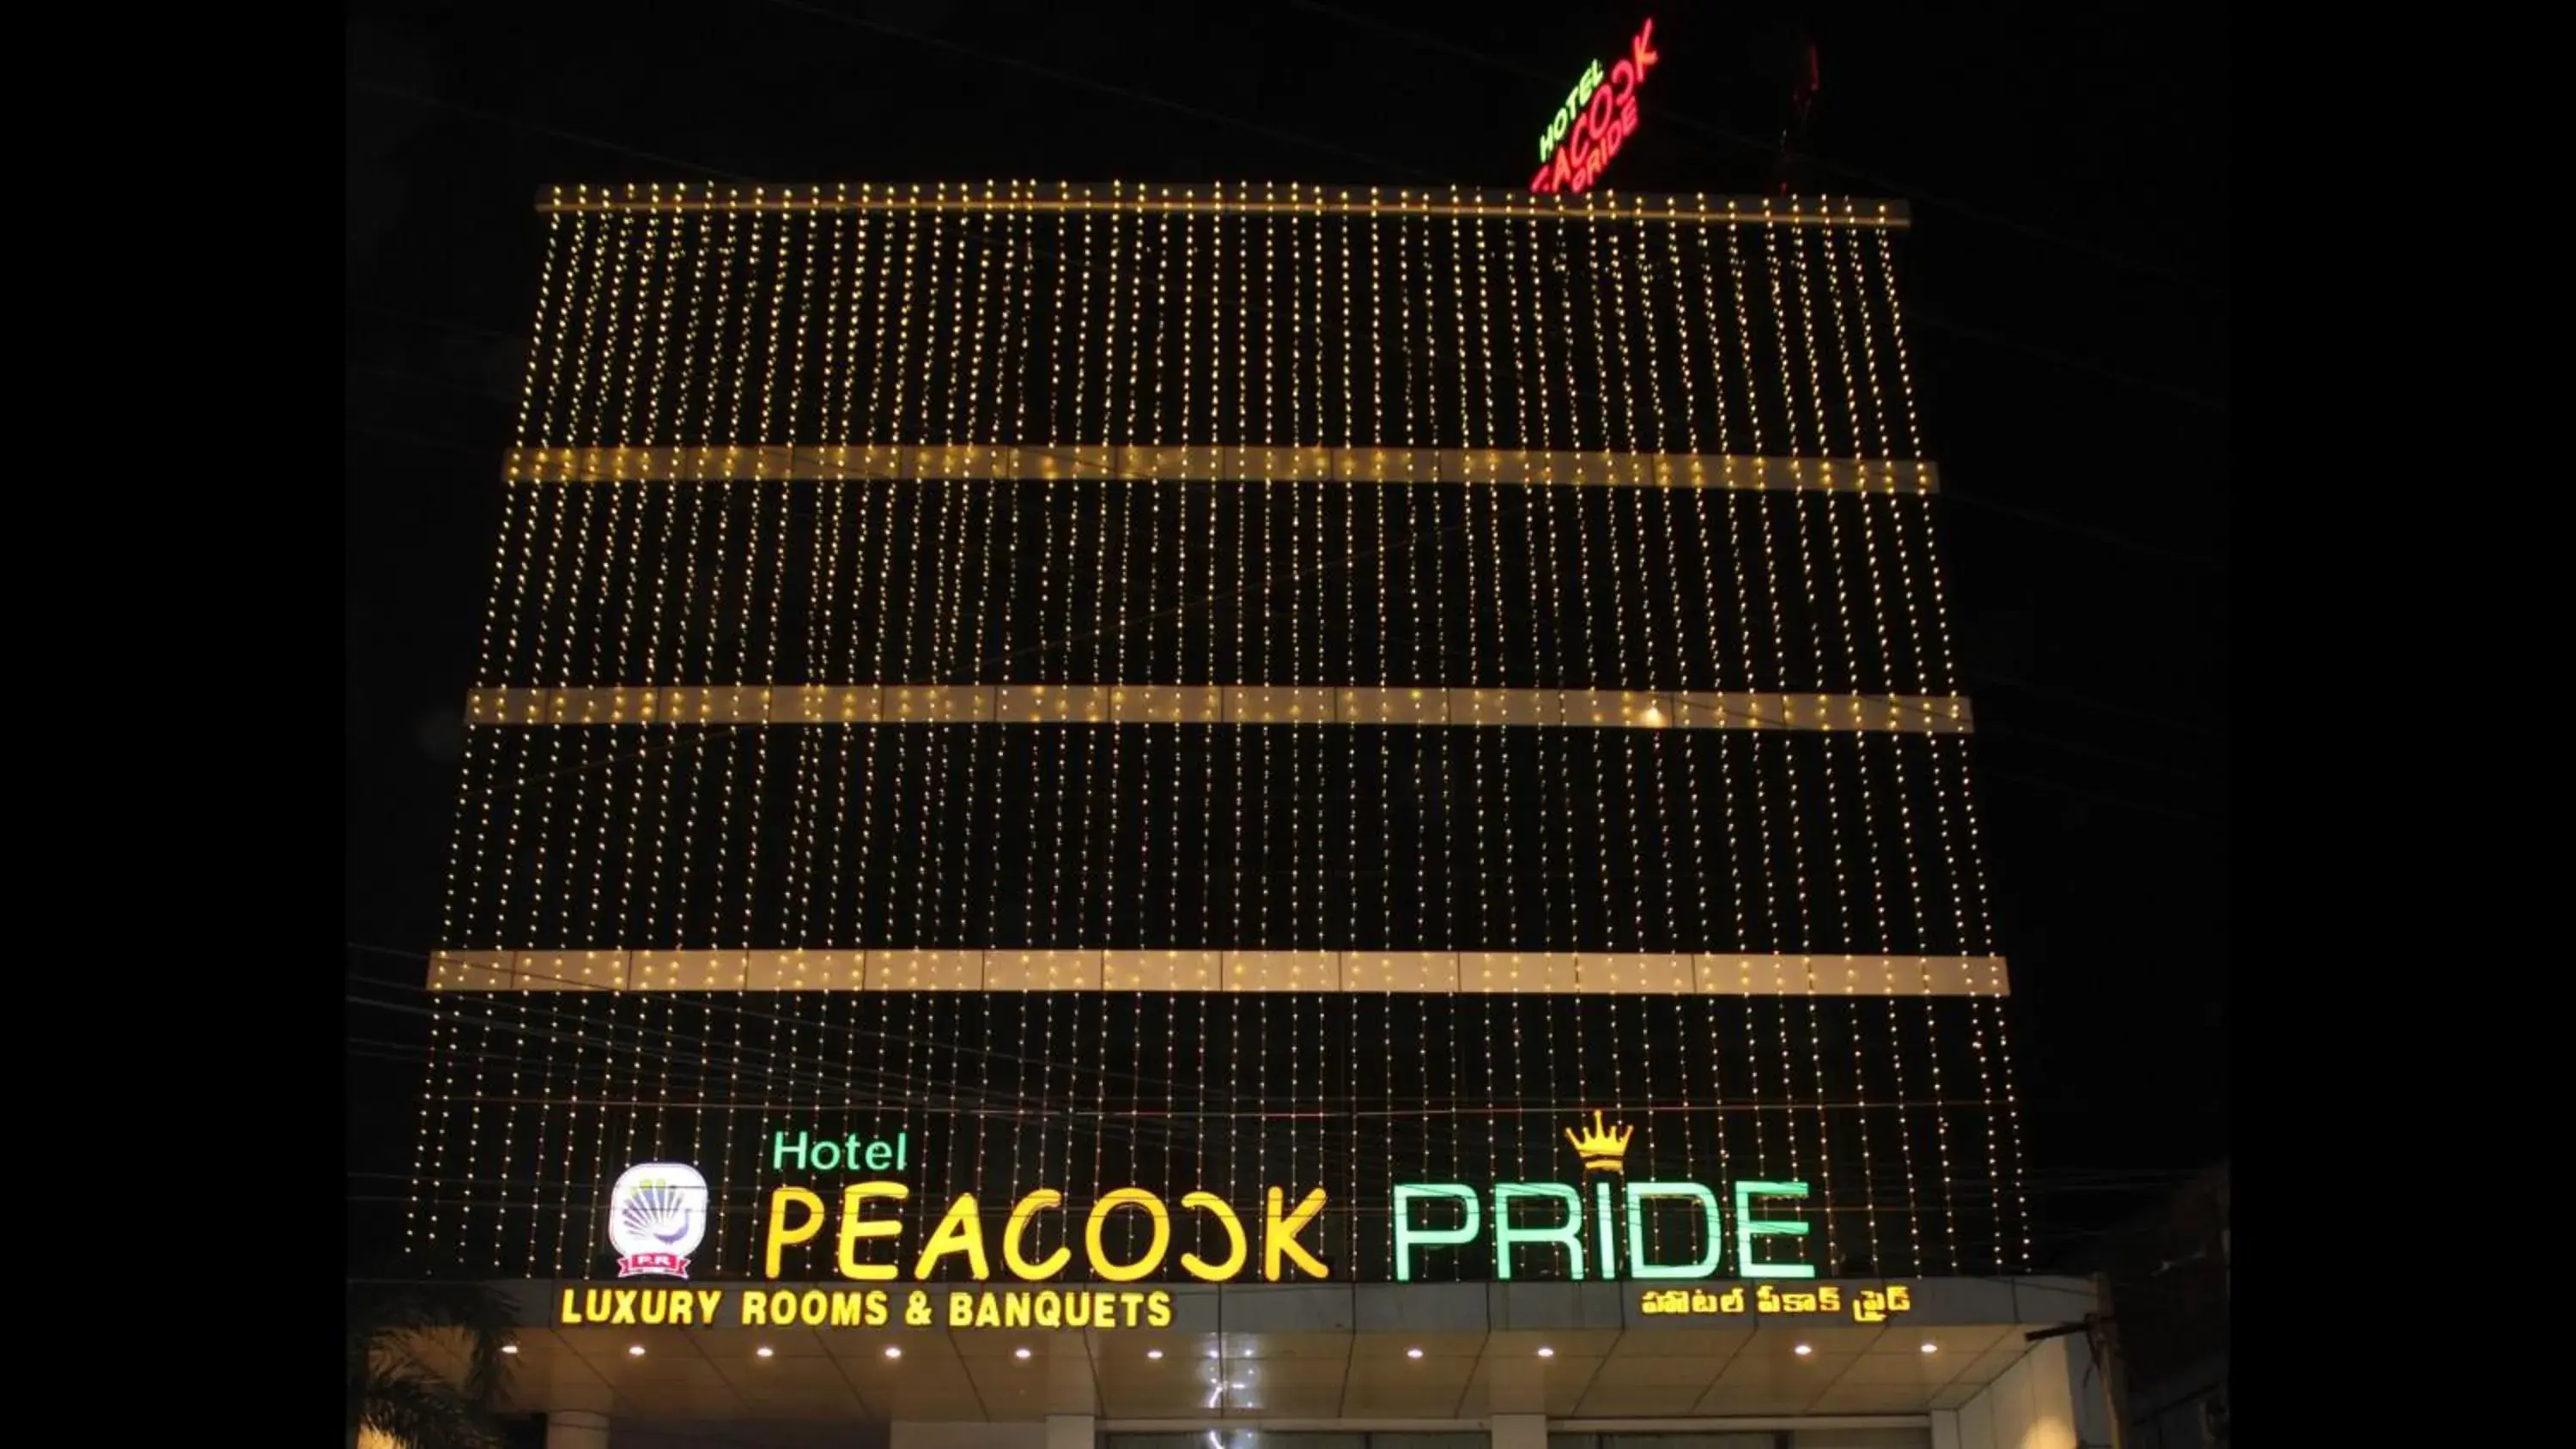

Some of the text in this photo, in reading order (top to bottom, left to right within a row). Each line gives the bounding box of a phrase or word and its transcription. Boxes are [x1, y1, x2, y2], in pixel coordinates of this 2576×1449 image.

[1540, 58, 1604, 163] HOTEL
[1571, 94, 1639, 193] PRIDE
[772, 1130, 908, 1172] Hotel
[764, 1180, 1815, 1282] PEACOCK PRIDE
[561, 1288, 1172, 1329] LUXURY ROOMS & BANQUETS
[1756, 1284, 1842, 1313] పీకాక్
